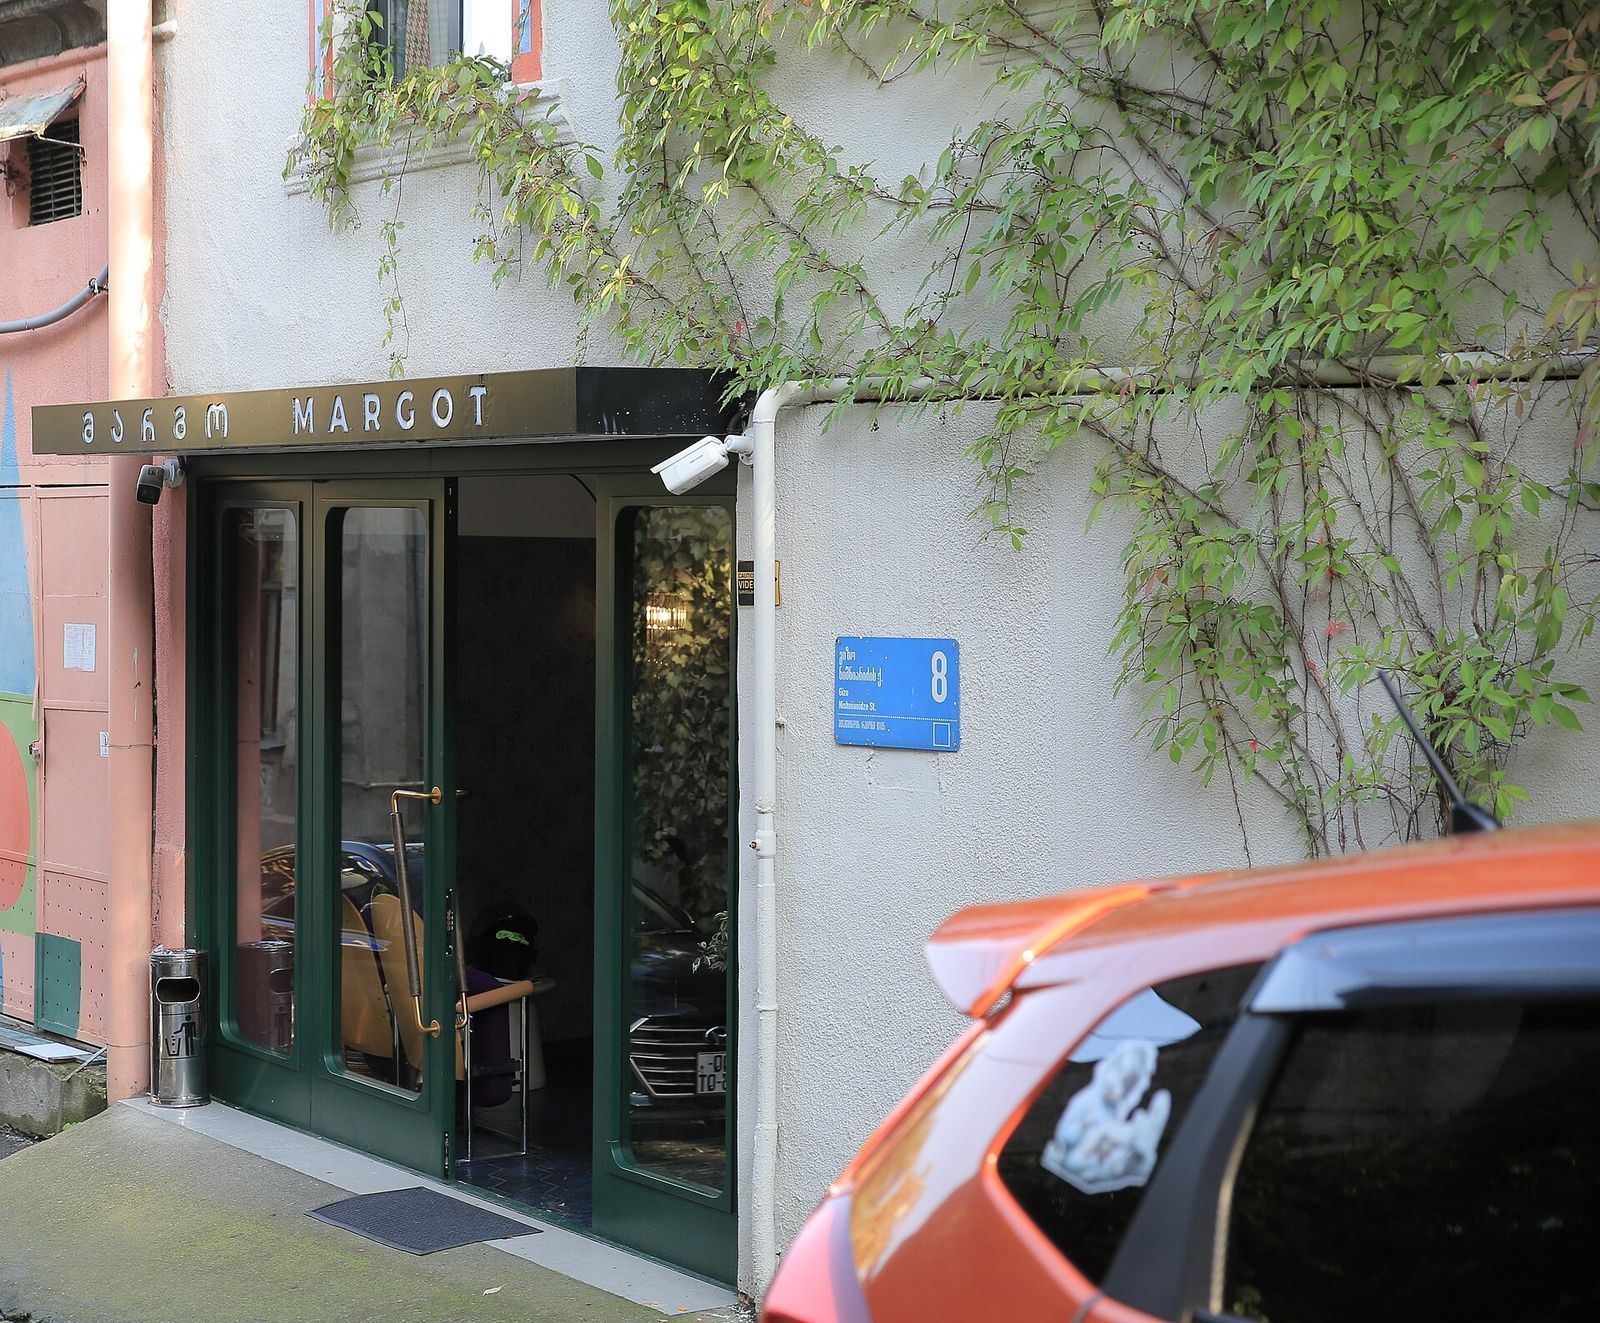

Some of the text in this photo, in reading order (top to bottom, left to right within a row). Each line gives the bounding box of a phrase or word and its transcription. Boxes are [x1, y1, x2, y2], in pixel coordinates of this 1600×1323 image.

[81, 402, 230, 444] მარგო
[292, 385, 488, 436] MARGOT
[738, 580, 754, 589] VIDE
[931, 650, 948, 703] 8
[838, 687, 849, 697] Gizo
[838, 700, 877, 711] Nishnianidze St.
